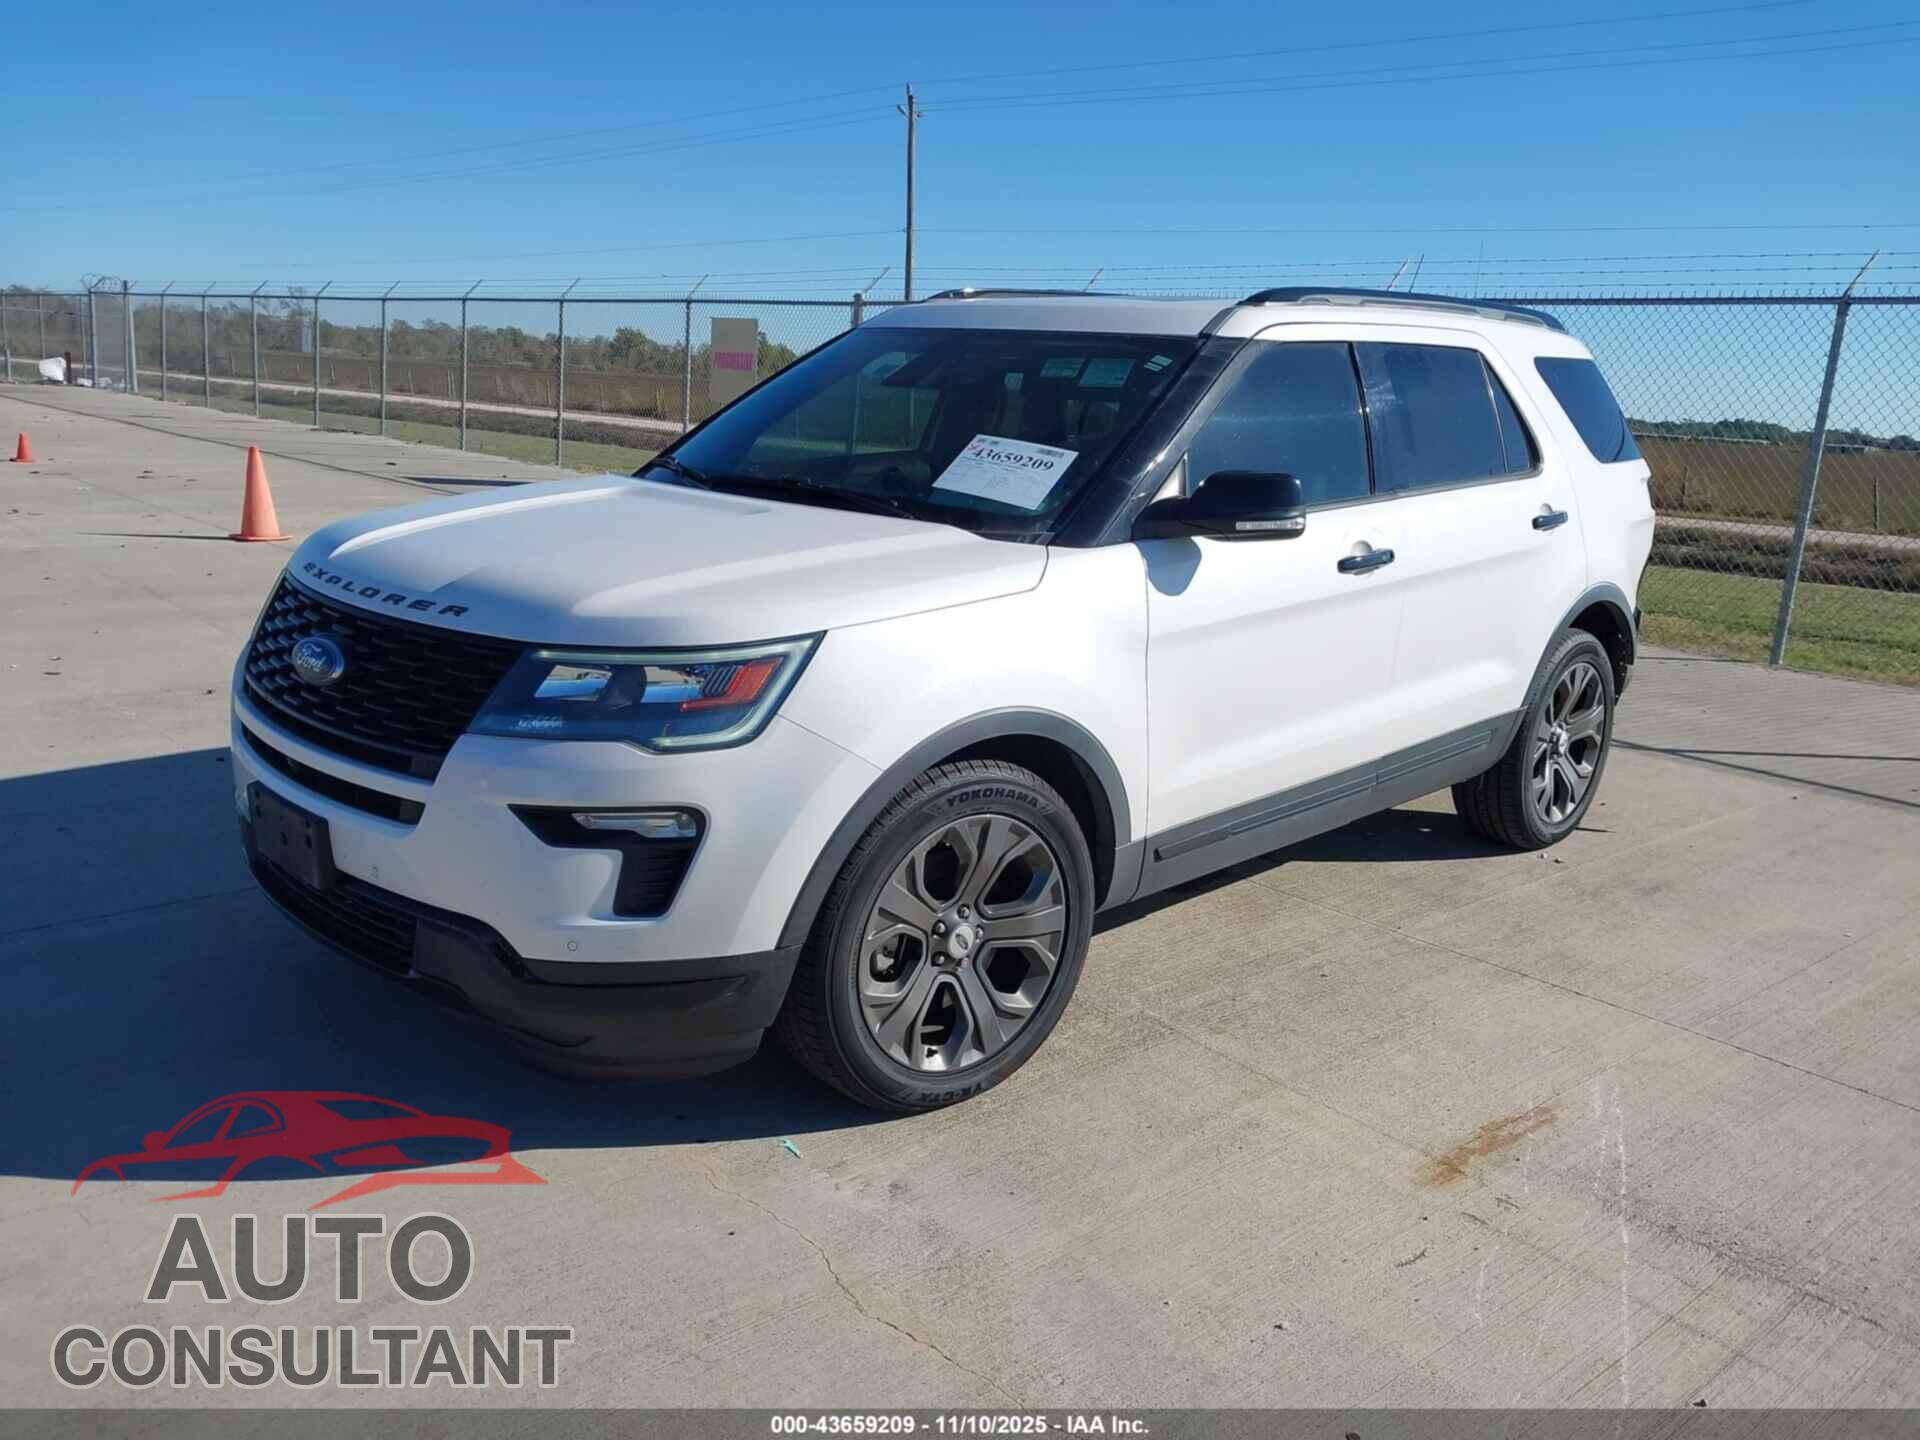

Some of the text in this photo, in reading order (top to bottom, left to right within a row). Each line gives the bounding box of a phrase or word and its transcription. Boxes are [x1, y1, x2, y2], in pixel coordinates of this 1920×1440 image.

[974, 447, 1055, 471] 43659209
[303, 562, 470, 617] EXPLORER
[296, 642, 327, 673] Ford
[946, 787, 1040, 808] YOKOHAMA
